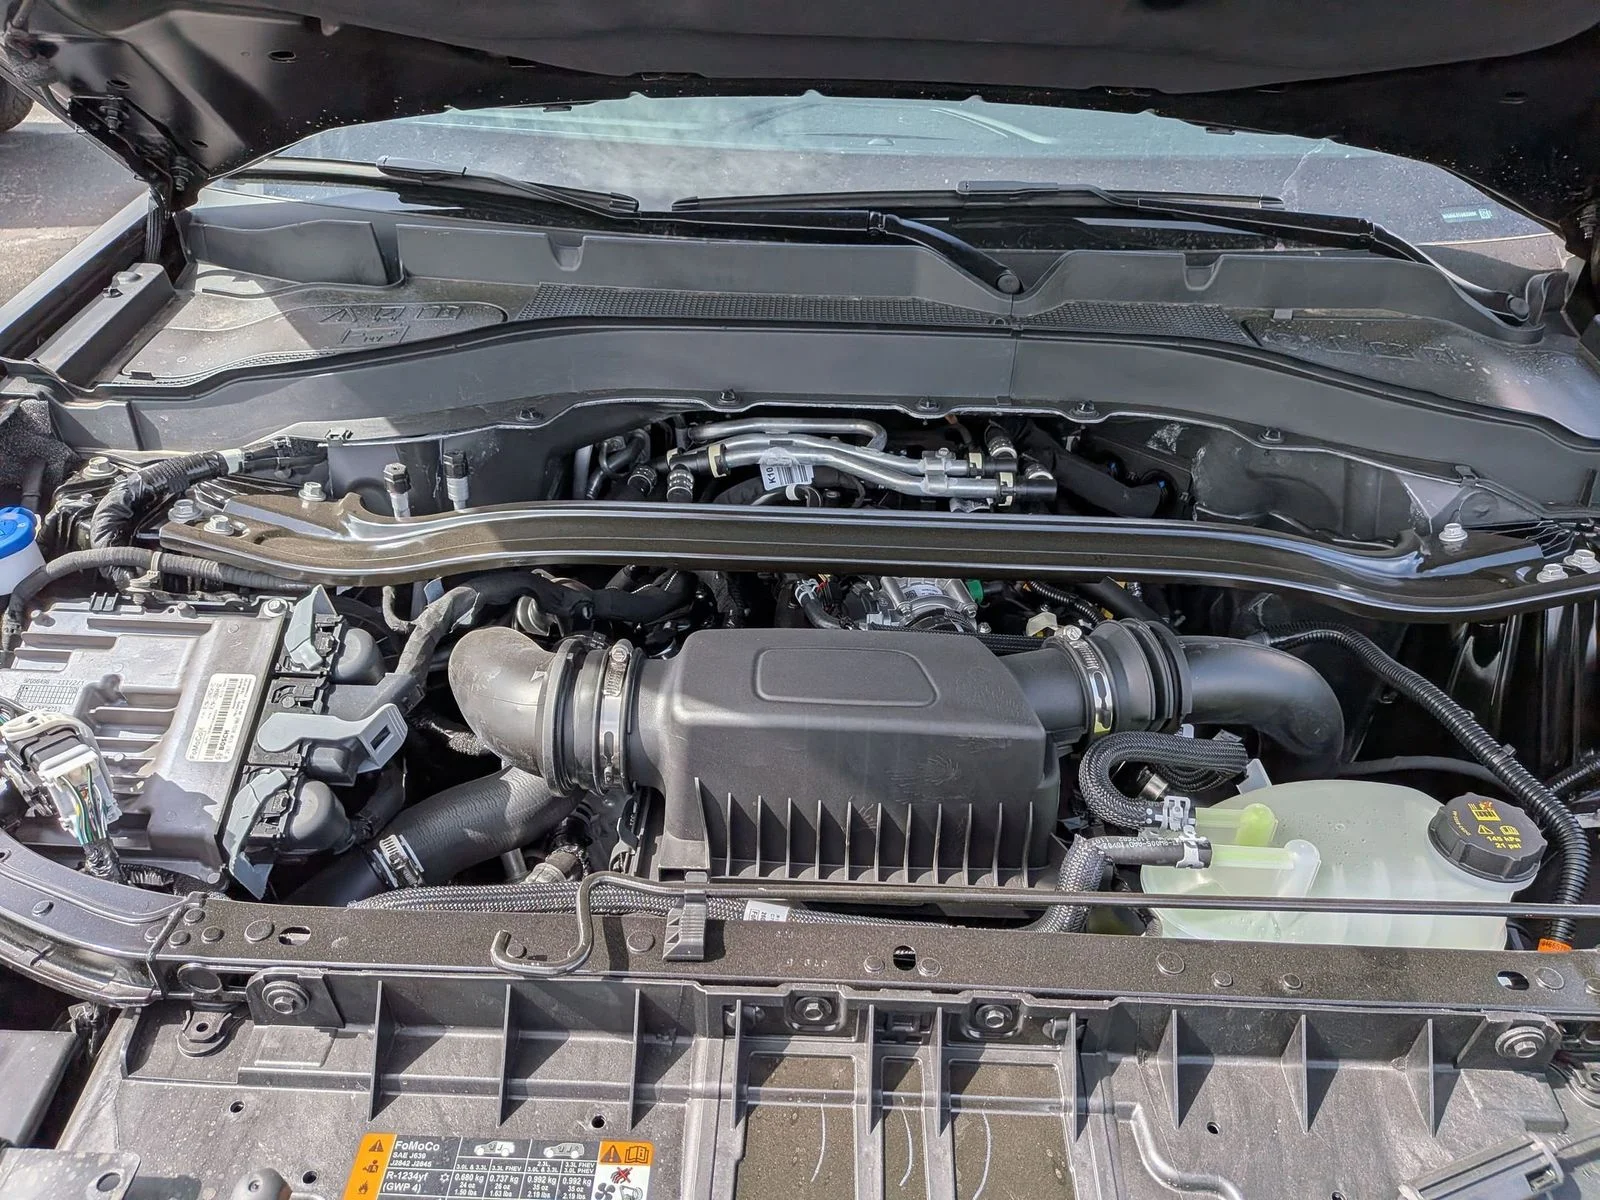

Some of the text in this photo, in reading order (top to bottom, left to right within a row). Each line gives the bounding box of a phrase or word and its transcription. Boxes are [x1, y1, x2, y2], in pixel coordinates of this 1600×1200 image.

[218, 730, 230, 750] BOSCH
[394, 1140, 440, 1152] FoMoCo
[386, 1171, 428, 1181] R-1234yf
[475, 1174, 485, 1183] kg
[510, 1176, 519, 1184] kg
[527, 1176, 557, 1186] 0.992 kg
[584, 1178, 592, 1186] kg
[382, 1182, 422, 1194] (GWP 4)
